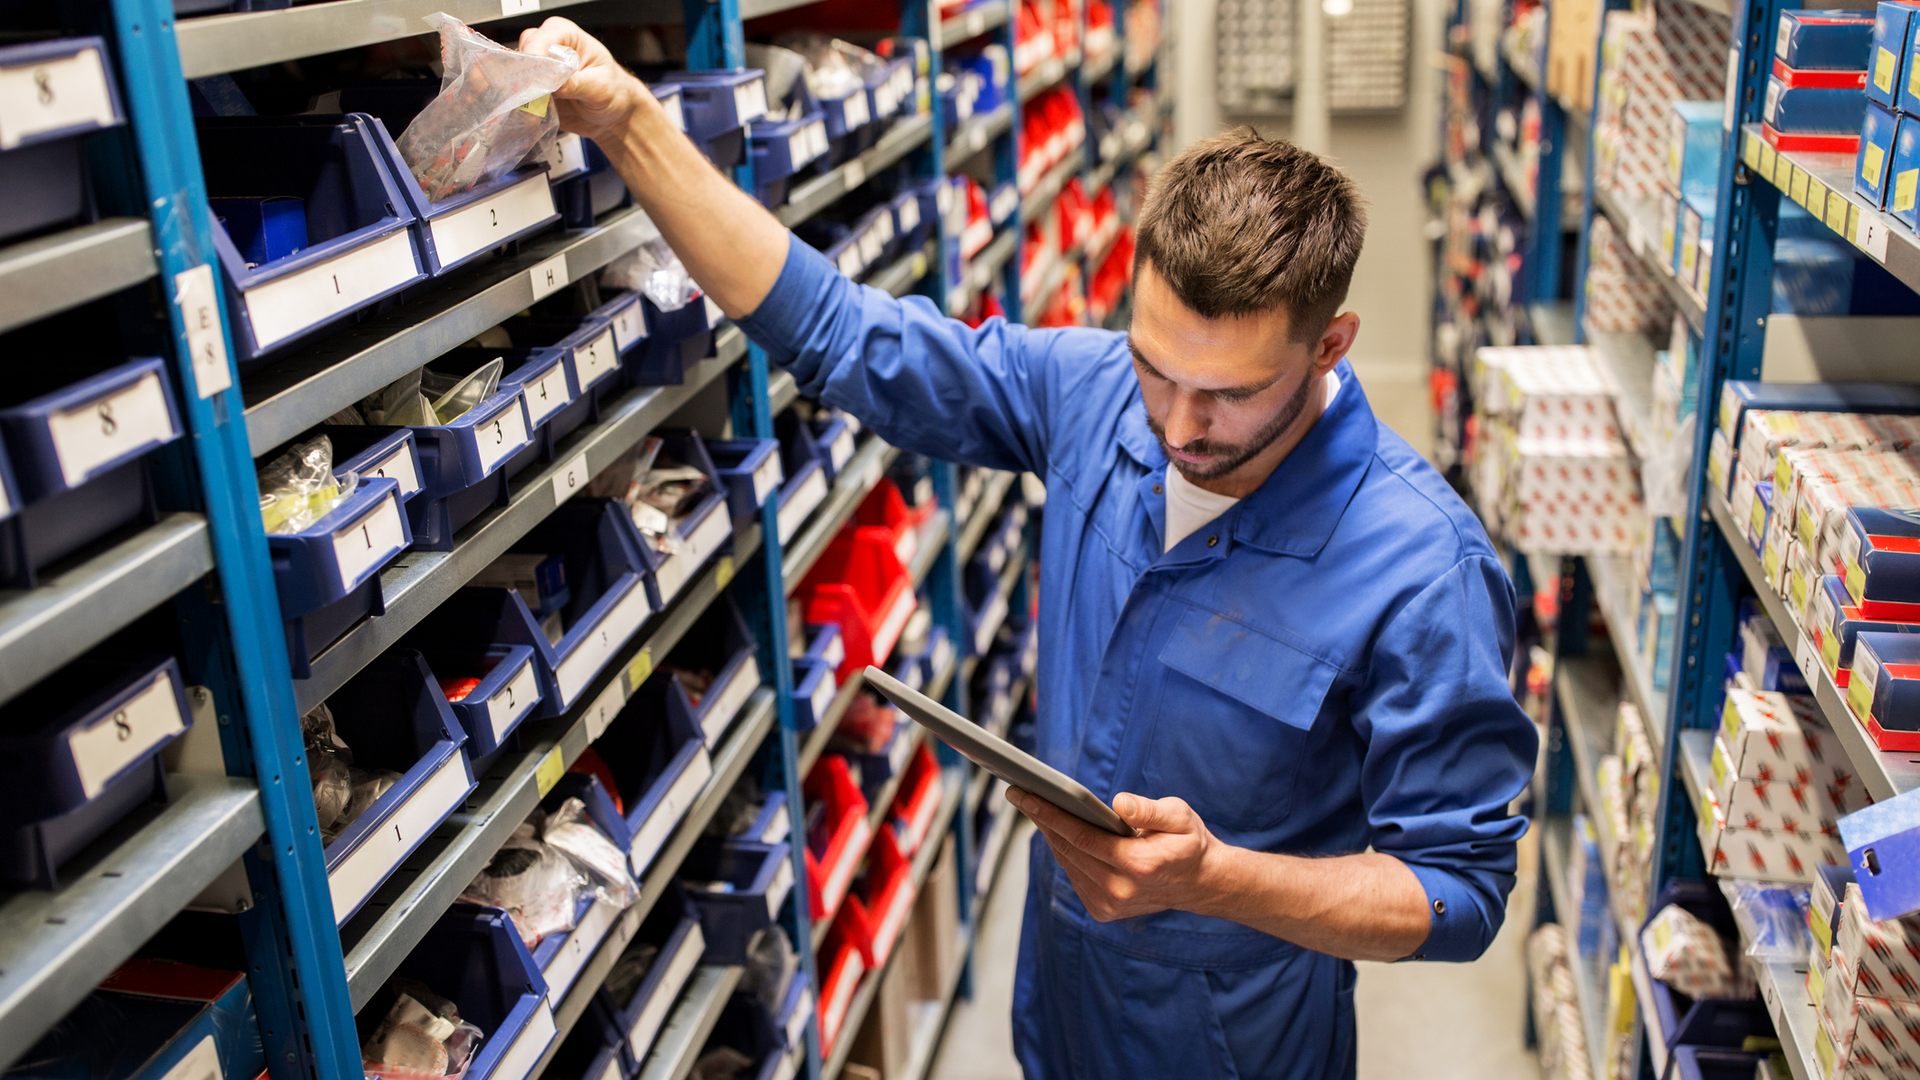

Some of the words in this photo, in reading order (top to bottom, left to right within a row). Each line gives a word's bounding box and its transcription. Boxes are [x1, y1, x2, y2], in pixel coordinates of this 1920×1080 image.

[33, 66, 56, 106] 8
[556, 141, 563, 164] 3
[490, 208, 497, 227] 2
[1867, 226, 1873, 245] F
[333, 275, 341, 294] 1
[546, 268, 554, 287] H
[199, 306, 211, 330] E
[589, 343, 596, 365] 5
[540, 379, 547, 400] 4
[97, 402, 118, 436] 8
[493, 420, 502, 444] 3
[567, 471, 575, 487] G
[362, 524, 372, 550] 1
[1805, 656, 1810, 675] E
[506, 687, 515, 709] 2
[113, 710, 132, 742] 8
[394, 824, 402, 843] 1
